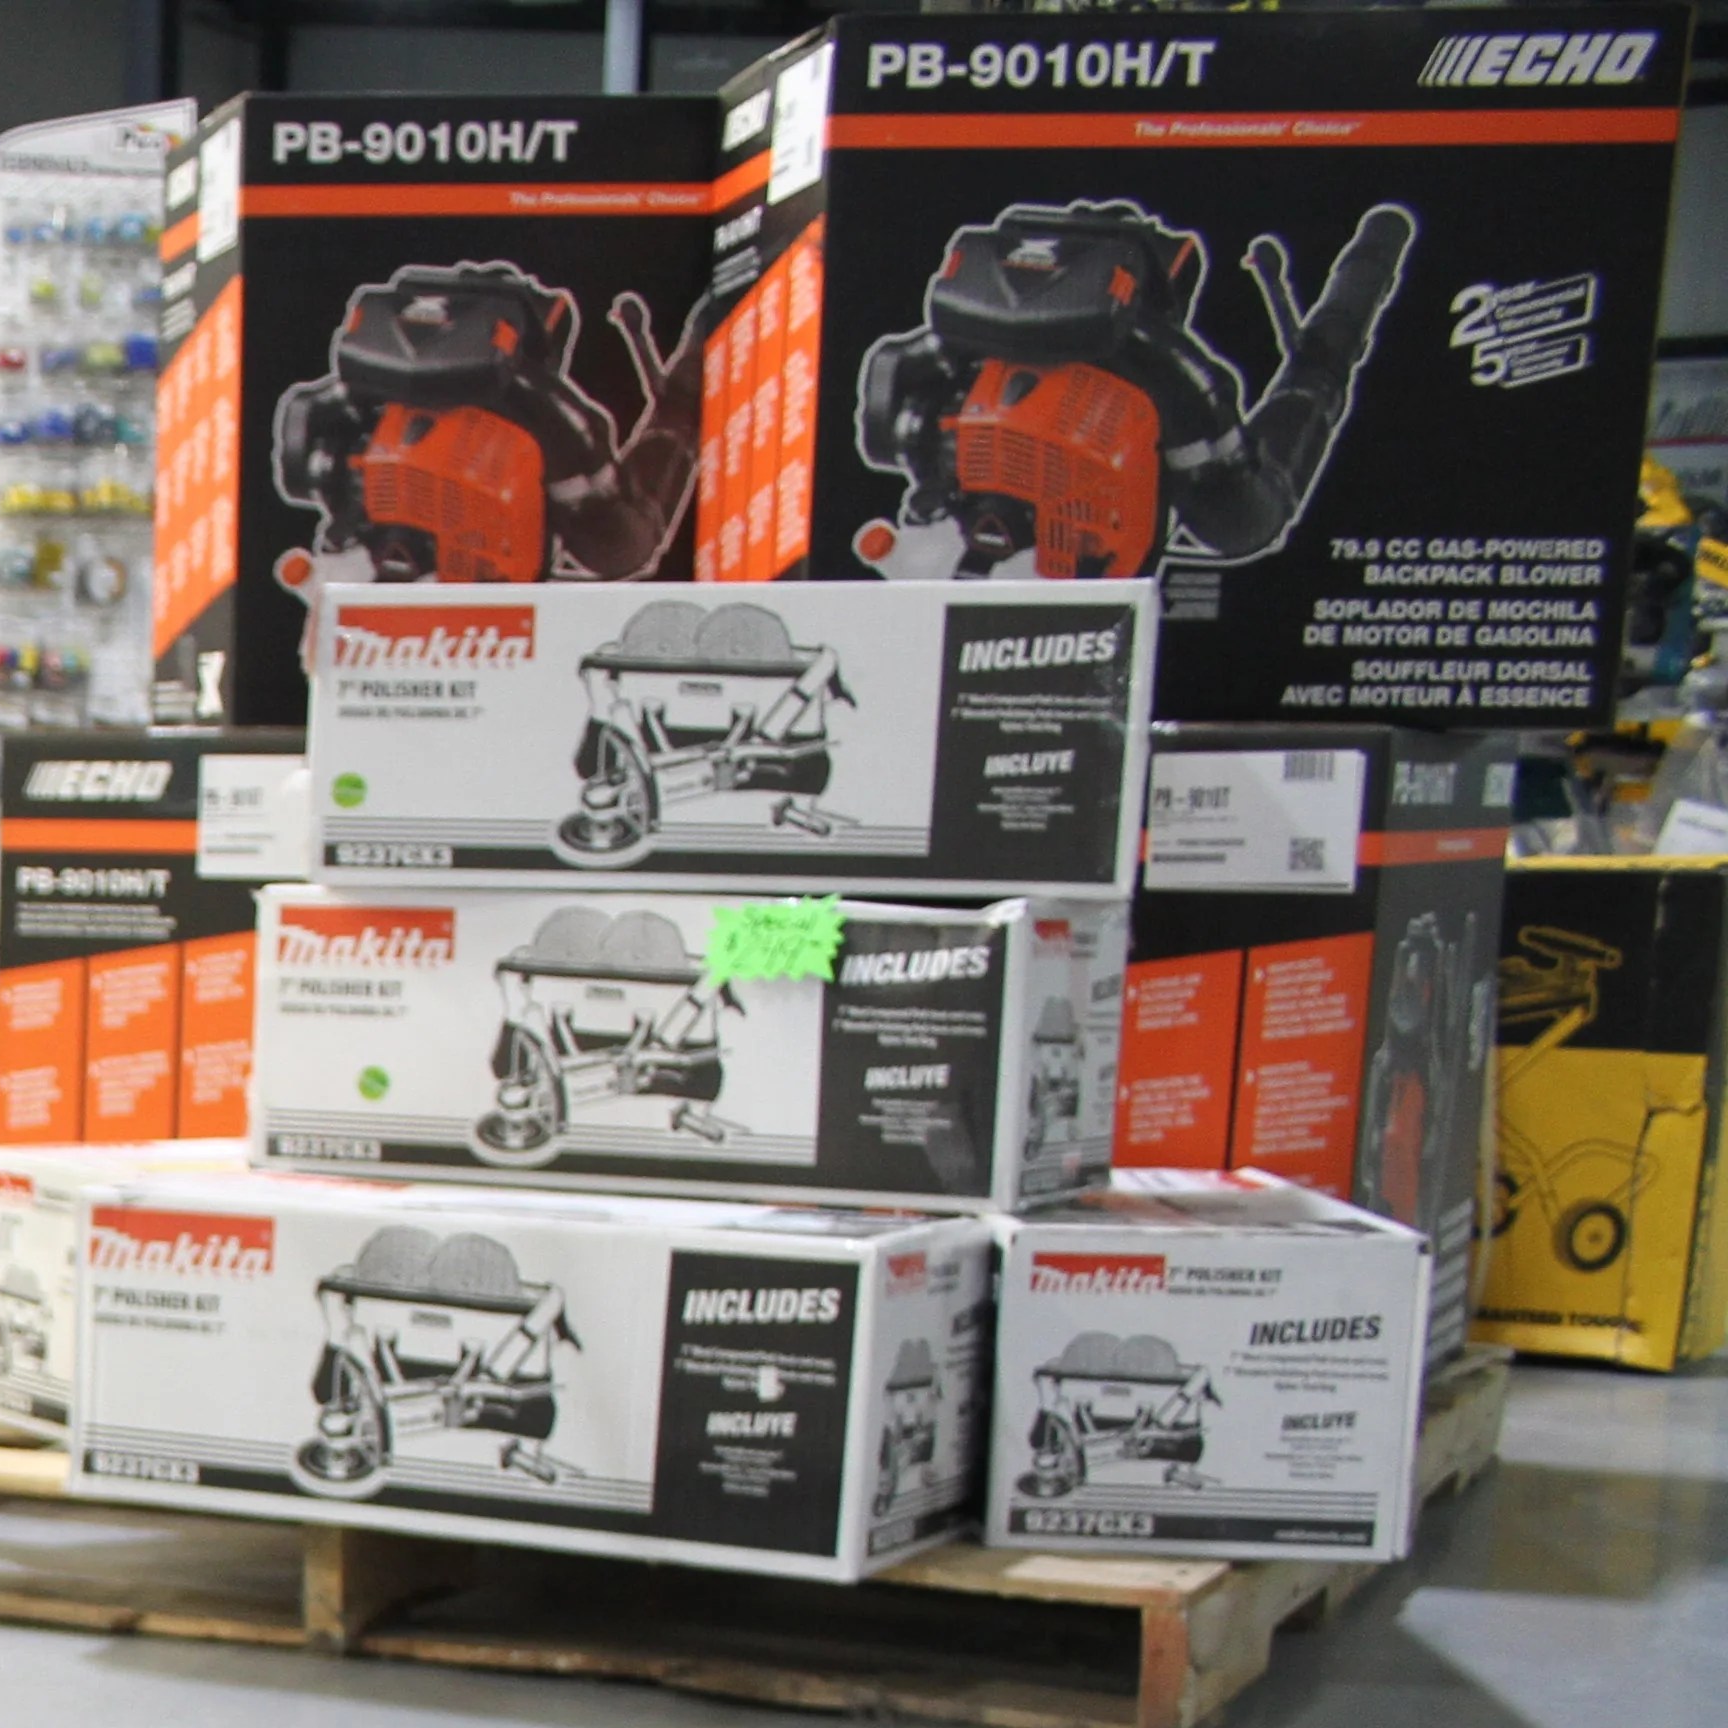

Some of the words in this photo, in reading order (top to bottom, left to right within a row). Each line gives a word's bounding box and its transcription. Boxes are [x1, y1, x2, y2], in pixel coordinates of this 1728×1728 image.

[866, 41, 1216, 88] PB-9010H/T
[1462, 33, 1656, 87] ECHO
[272, 120, 578, 164] PB-9010H/T
[1448, 282, 1497, 349] 2
[1470, 337, 1508, 387] 5
[1385, 538, 1421, 560] CC
[1426, 538, 1606, 561] GAS-POWERED
[1363, 564, 1495, 587] BACKPACK
[1499, 564, 1603, 587] BLOWER
[1313, 599, 1443, 622] SOPLADOR
[1447, 599, 1482, 622] DE
[1488, 599, 1598, 622] MOCHILA
[1303, 625, 1337, 646] DE
[1341, 625, 1430, 646] MOTOR
[1435, 625, 1469, 646] DE
[1474, 625, 1595, 646] GASOLINA
[958, 630, 1118, 673] INCLUDES
[1351, 660, 1491, 683] SOUFFLEUR
[1496, 660, 1592, 682] DORSAL
[1281, 685, 1342, 708] AVEC
[1349, 685, 1451, 708] MOTEUR
[1479, 685, 1590, 708] ESSENCE
[983, 749, 1075, 778] INCLUYE
[52, 760, 174, 801] ECHO
[839, 946, 991, 986] INCLUDES
[864, 1064, 951, 1091] INCLUYE
[682, 1287, 841, 1325] INCLUDES
[1249, 1314, 1382, 1346] INCLUDES
[705, 1411, 798, 1438] INCLUYE
[1281, 1409, 1358, 1431] INCLUYE
